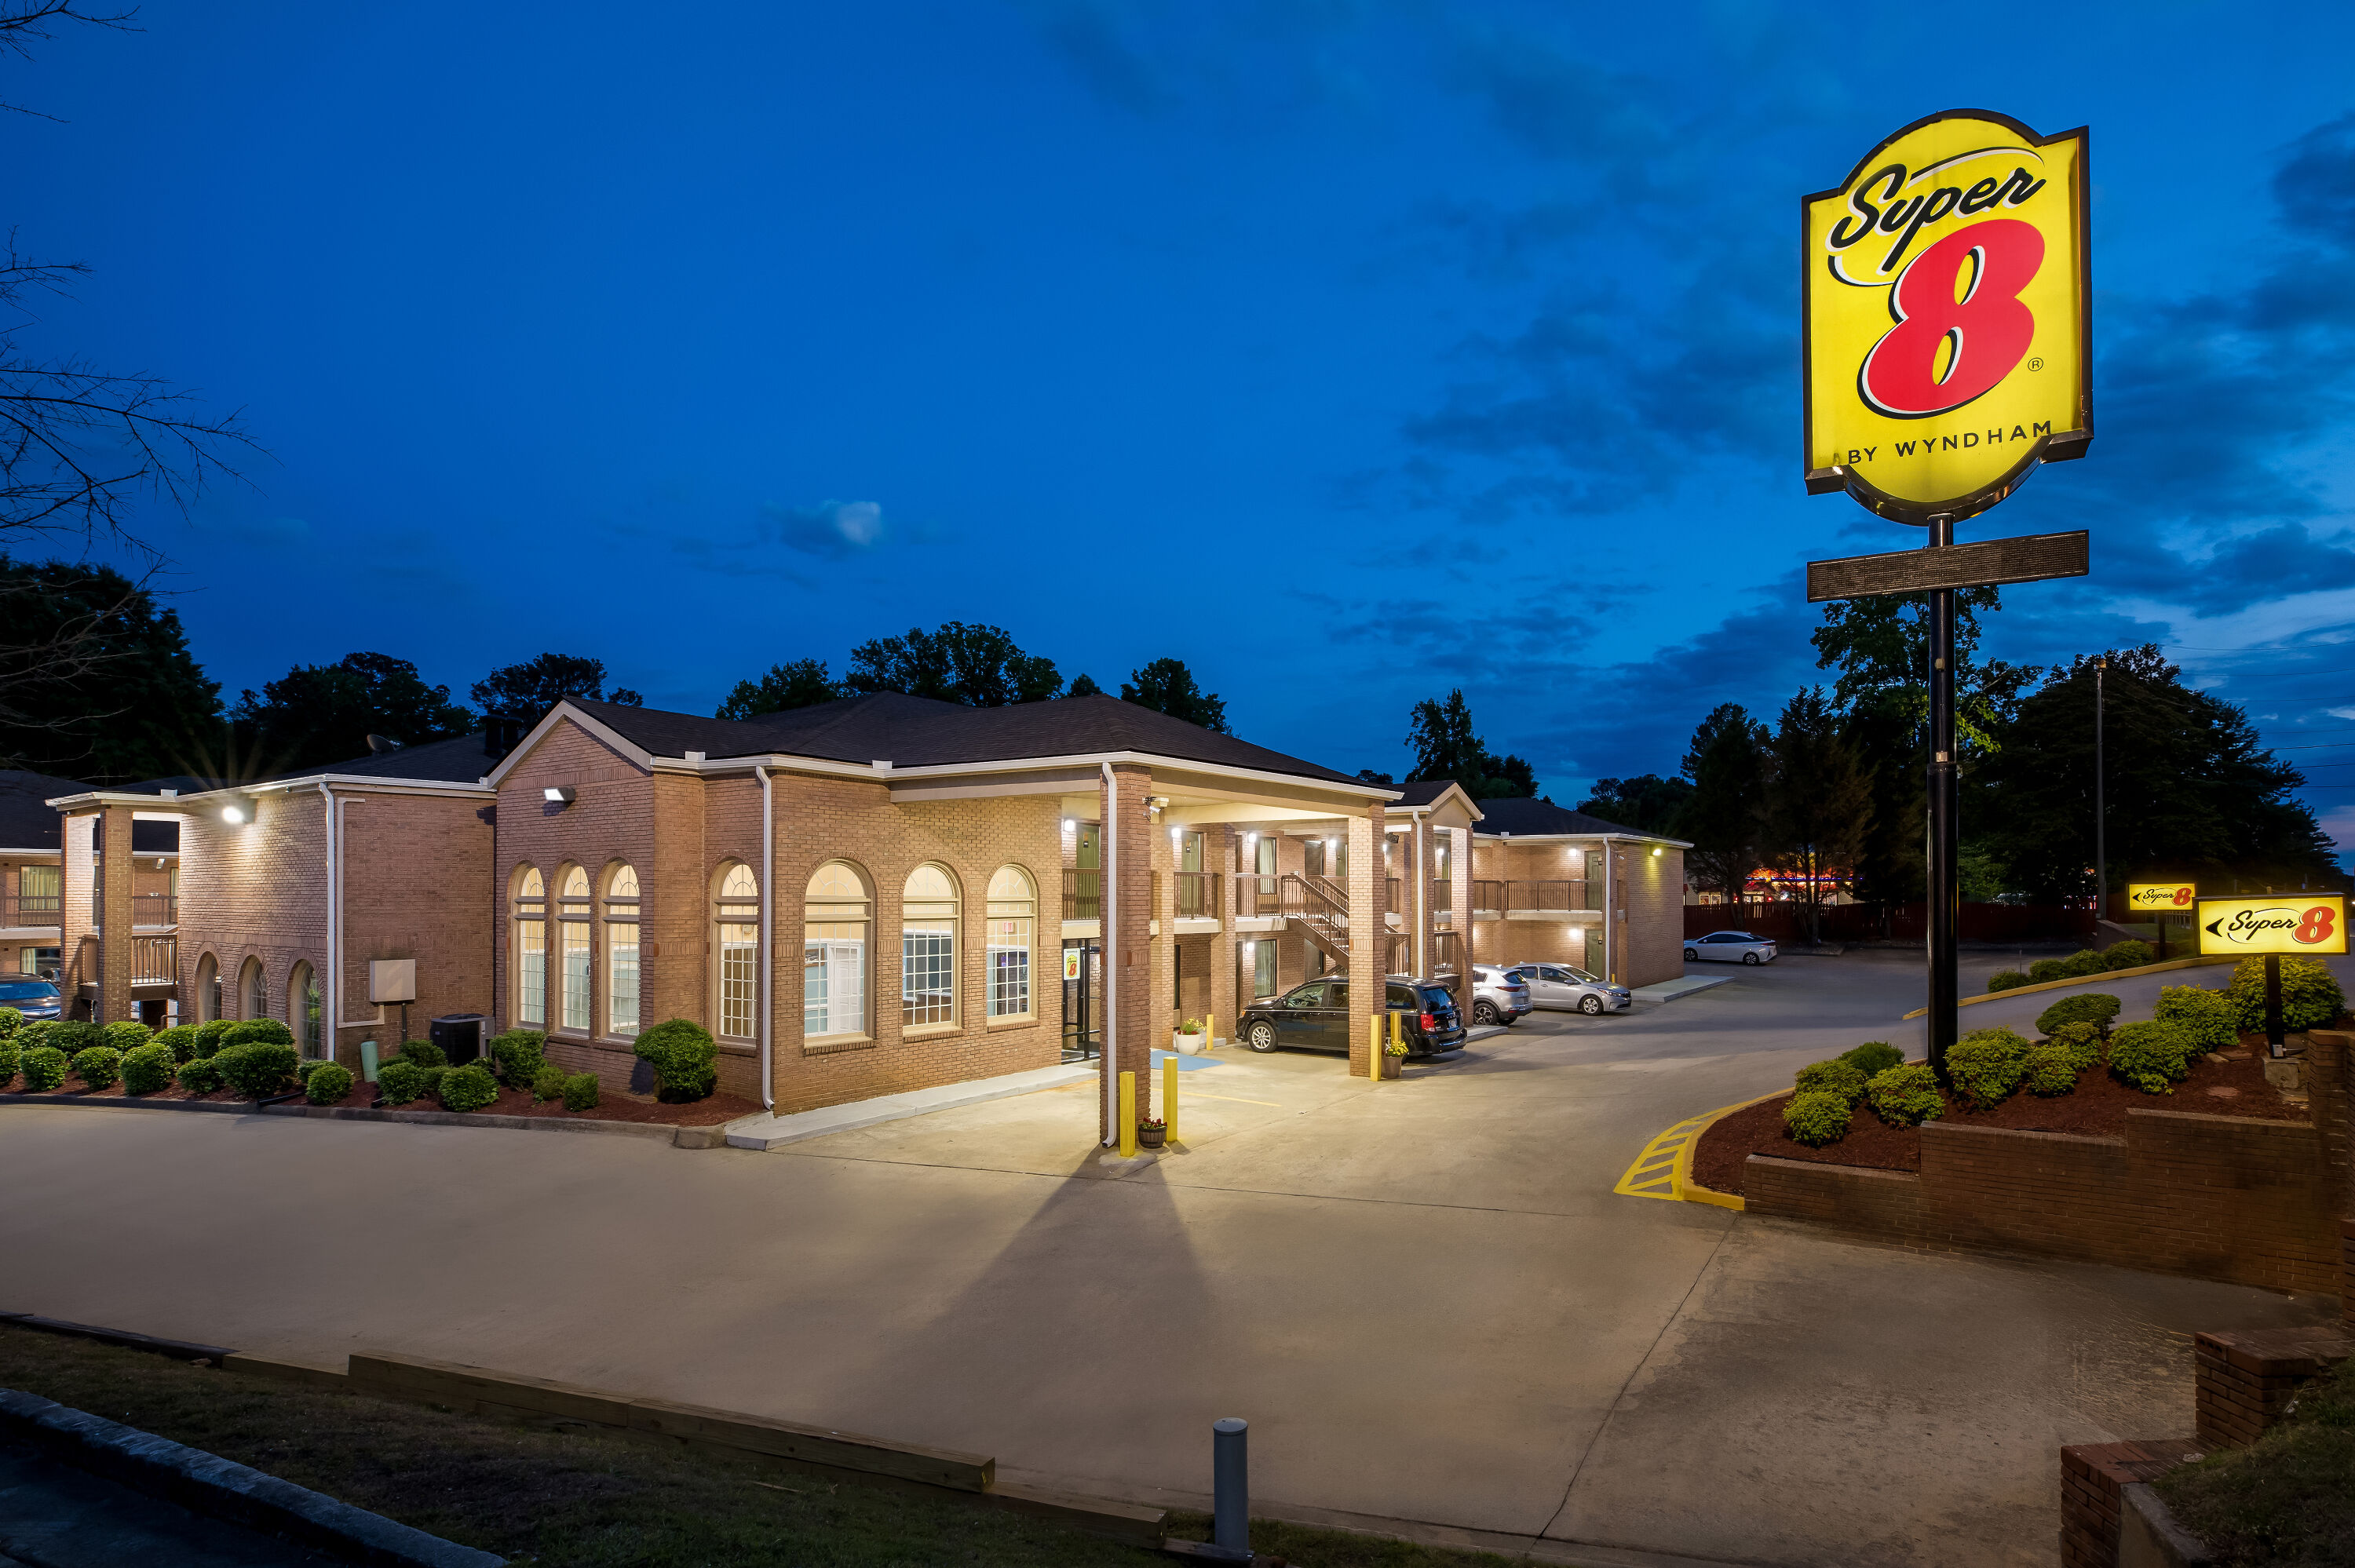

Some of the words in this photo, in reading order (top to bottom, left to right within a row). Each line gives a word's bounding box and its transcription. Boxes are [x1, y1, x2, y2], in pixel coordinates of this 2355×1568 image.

[1829, 163, 2047, 273] Super
[1857, 219, 2045, 419] 8
[1849, 447, 1878, 465] BY
[1895, 421, 2052, 458] WYNDHAM
[2143, 888, 2174, 904] Super
[2173, 888, 2192, 906] 8
[2228, 910, 2298, 940] Super
[2293, 906, 2335, 944] 8
[1069, 963, 1077, 976] 8
